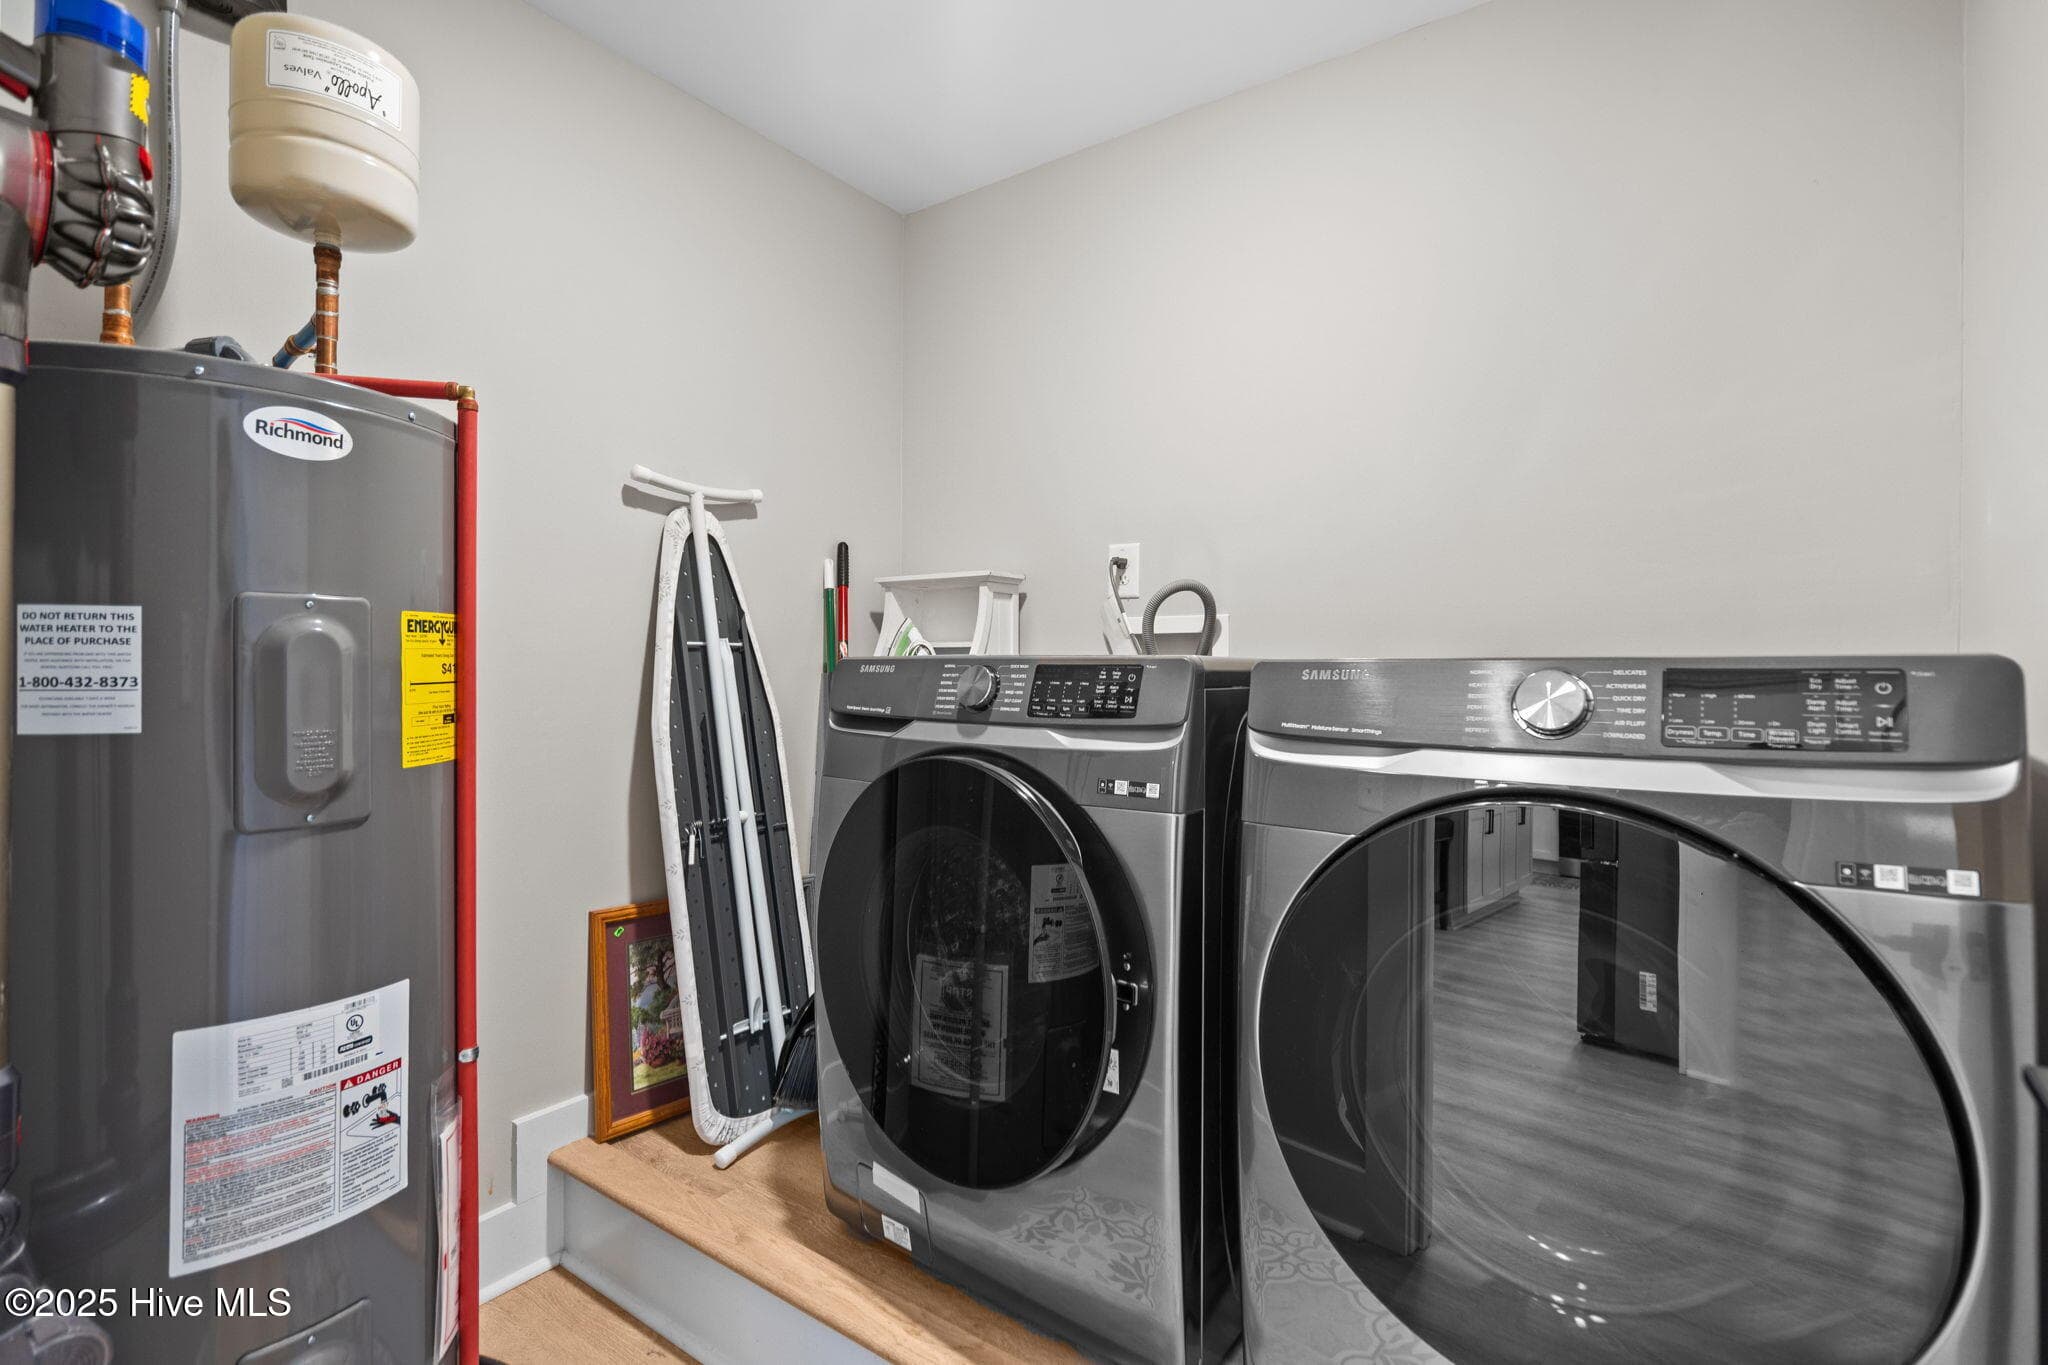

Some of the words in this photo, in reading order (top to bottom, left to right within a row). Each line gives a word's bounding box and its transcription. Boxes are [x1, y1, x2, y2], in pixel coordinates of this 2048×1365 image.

[284, 63, 322, 80] Valves
[255, 419, 344, 449] Richmond
[22, 612, 37, 621] DO
[39, 612, 61, 621] NOT
[63, 612, 107, 621] RETURN
[110, 613, 135, 621] THIS
[20, 624, 54, 633] WATER
[56, 624, 96, 633] HEATER
[100, 625, 114, 633] TO
[116, 625, 137, 633] THE
[24, 636, 55, 645] PLACE
[57, 636, 72, 645] OF
[74, 637, 132, 646] PURCHASE
[859, 665, 896, 673] SAMSUNG
[1301, 669, 1370, 681] SAMSUNG
[19, 676, 139, 688] 1-800-432-8373
[356, 1061, 399, 1084] DANGER
